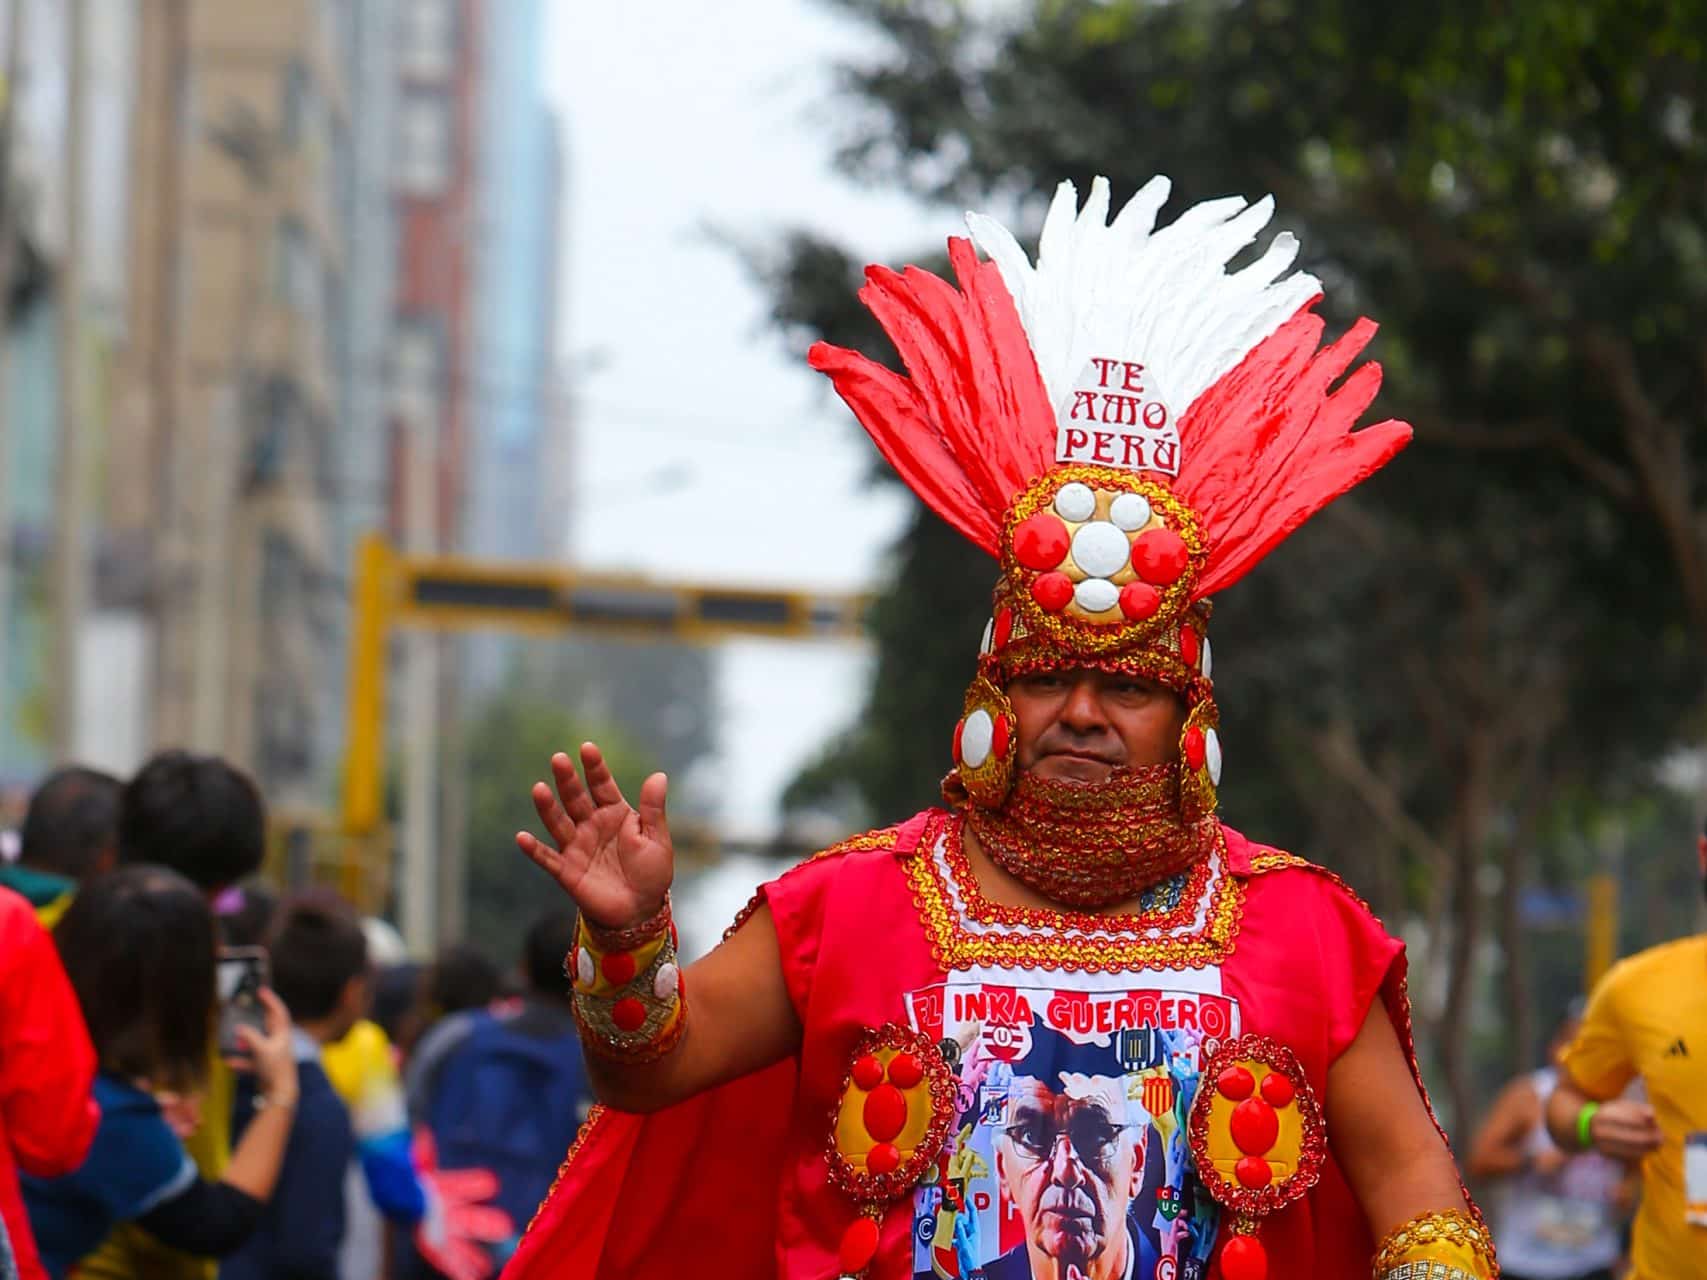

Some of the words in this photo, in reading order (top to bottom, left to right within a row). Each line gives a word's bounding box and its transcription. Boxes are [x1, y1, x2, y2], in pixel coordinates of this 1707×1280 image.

[1091, 358, 1144, 392] TE
[1070, 391, 1167, 429] AMO
[1063, 428, 1178, 471] PERÚ
[912, 995, 943, 1026] EL
[954, 992, 1035, 1027] INKA
[1047, 996, 1226, 1038] GUERRERO
[998, 1029, 1008, 1043] U
